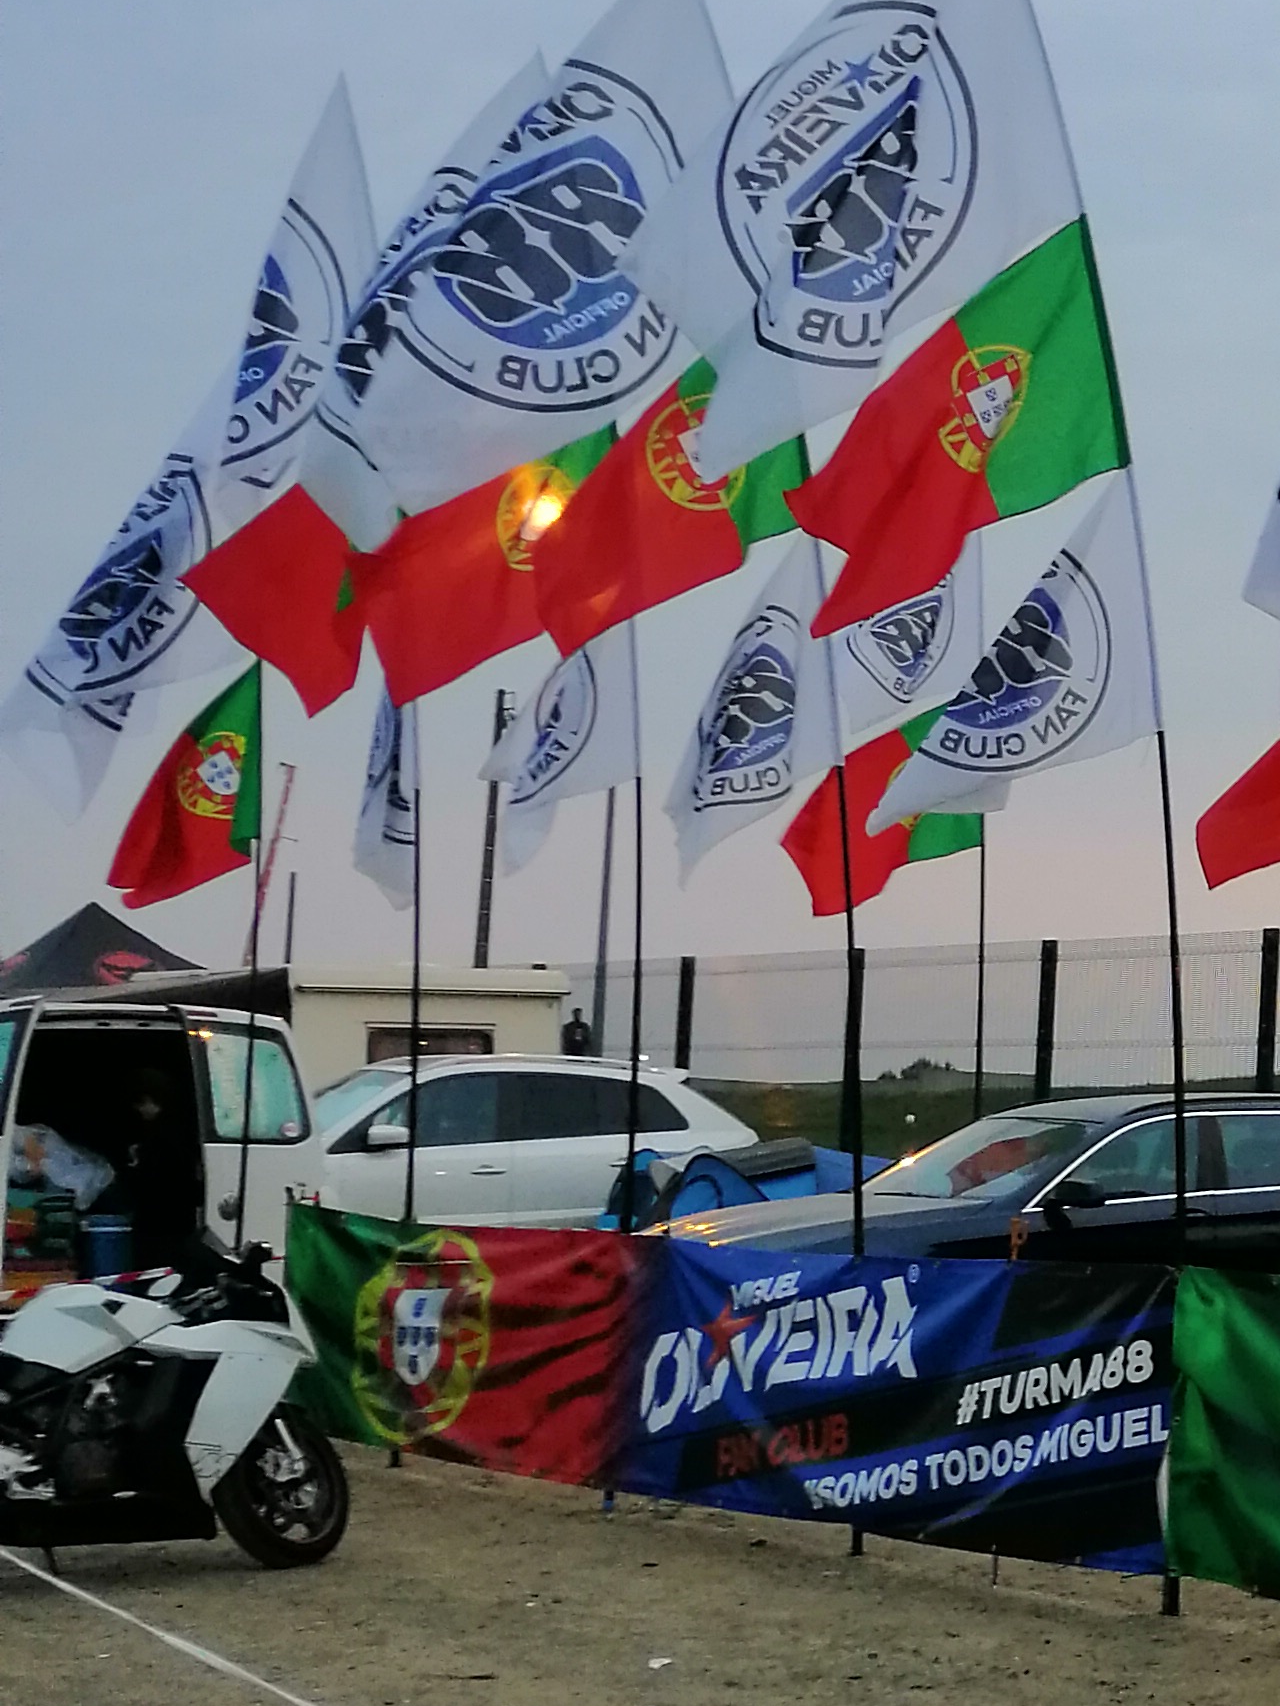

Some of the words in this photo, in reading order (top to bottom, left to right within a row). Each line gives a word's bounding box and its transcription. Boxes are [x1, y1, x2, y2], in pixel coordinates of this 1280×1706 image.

[640, 1275, 918, 1434] OLIVEIRA
[957, 1339, 1153, 1425] #TURMA88
[766, 1412, 849, 1466] CLUB
[925, 1435, 1030, 1491] TODOS
[1033, 1404, 1169, 1467] MIGUEL
